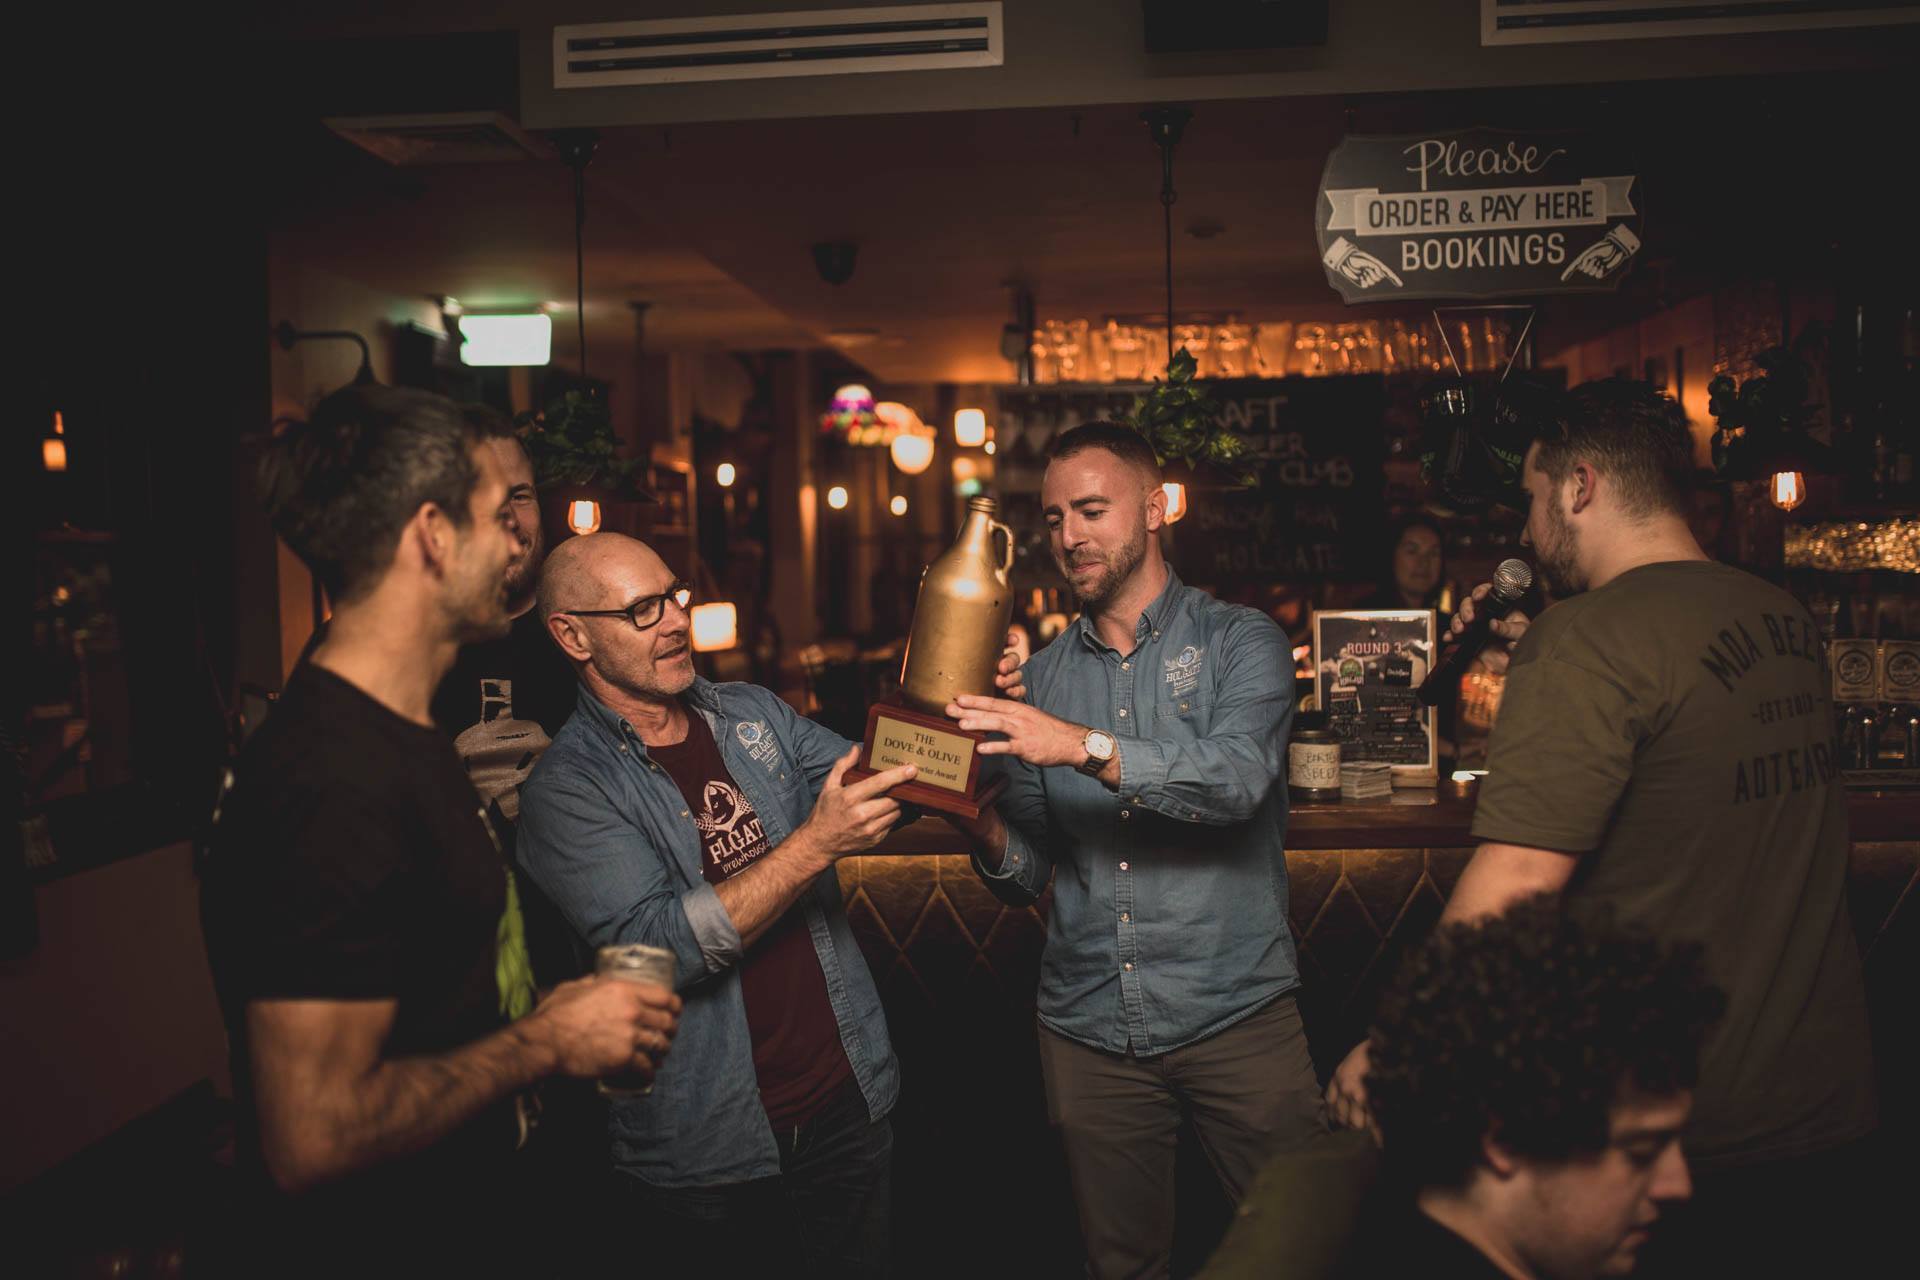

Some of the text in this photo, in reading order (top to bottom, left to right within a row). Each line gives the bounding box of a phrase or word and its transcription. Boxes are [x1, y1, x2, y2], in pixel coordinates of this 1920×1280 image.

[1403, 139, 1567, 191] Please
[1368, 189, 1594, 229] ORDER & PAY HERE
[1401, 232, 1566, 272] BOOKINGS
[1213, 395, 1289, 430] AFT
[1346, 641, 1403, 655] ROUND 3
[1701, 618, 1765, 694] MOA
[884, 737, 962, 766] DOVE & OLIVE
[914, 732, 936, 746] THE
[881, 755, 906, 767] Golden
[935, 768, 958, 781] Award
